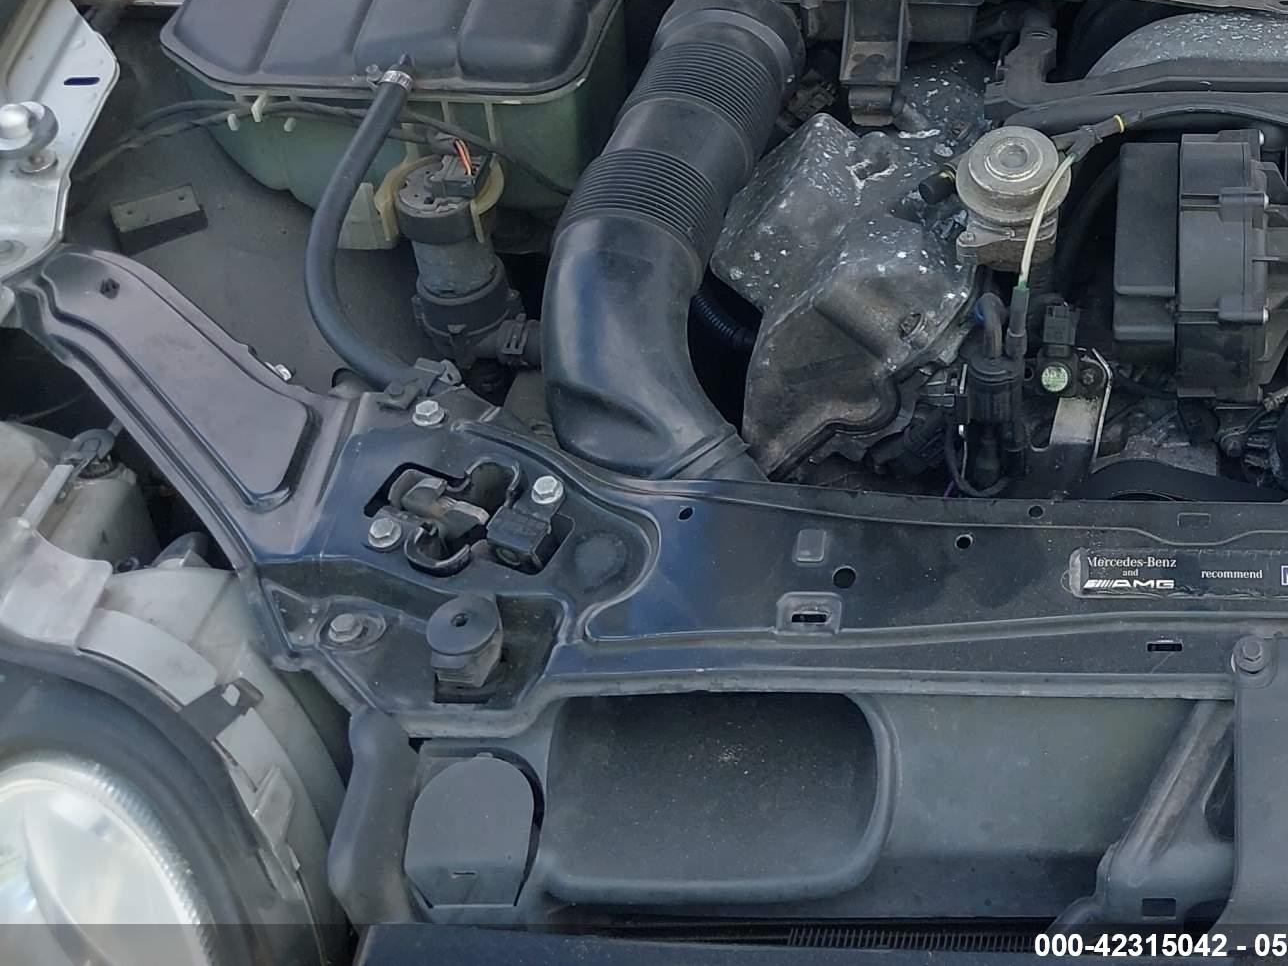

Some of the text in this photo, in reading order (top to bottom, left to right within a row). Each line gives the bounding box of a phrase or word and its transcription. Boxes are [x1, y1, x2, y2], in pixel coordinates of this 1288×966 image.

[1087, 556, 1177, 568] Mercedes-Benz
[1122, 568, 1139, 577] and
[1201, 569, 1263, 579] recommend
